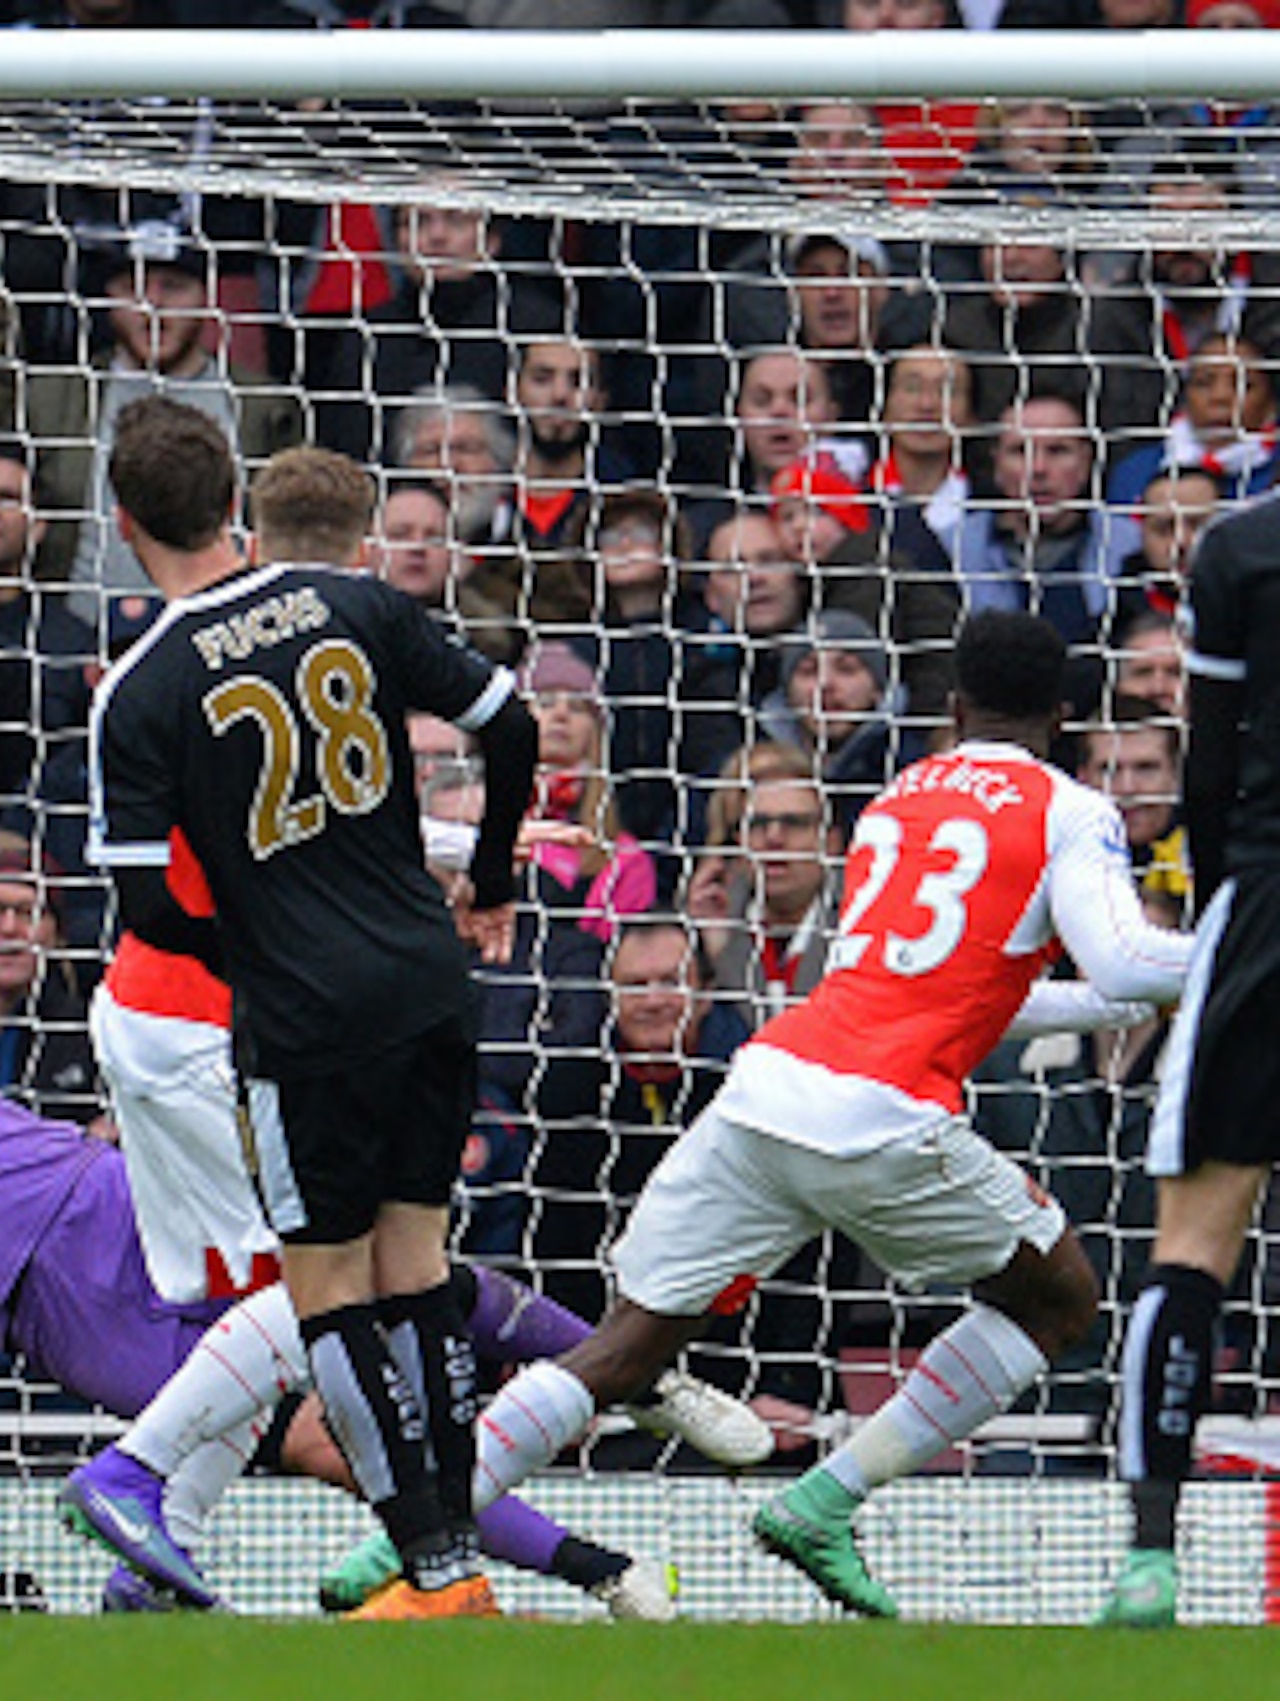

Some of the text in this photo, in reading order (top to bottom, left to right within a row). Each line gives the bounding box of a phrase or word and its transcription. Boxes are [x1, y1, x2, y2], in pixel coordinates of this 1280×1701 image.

[191, 586, 331, 670] FUCHS
[201, 638, 393, 861] 28
[824, 811, 990, 978] 23
